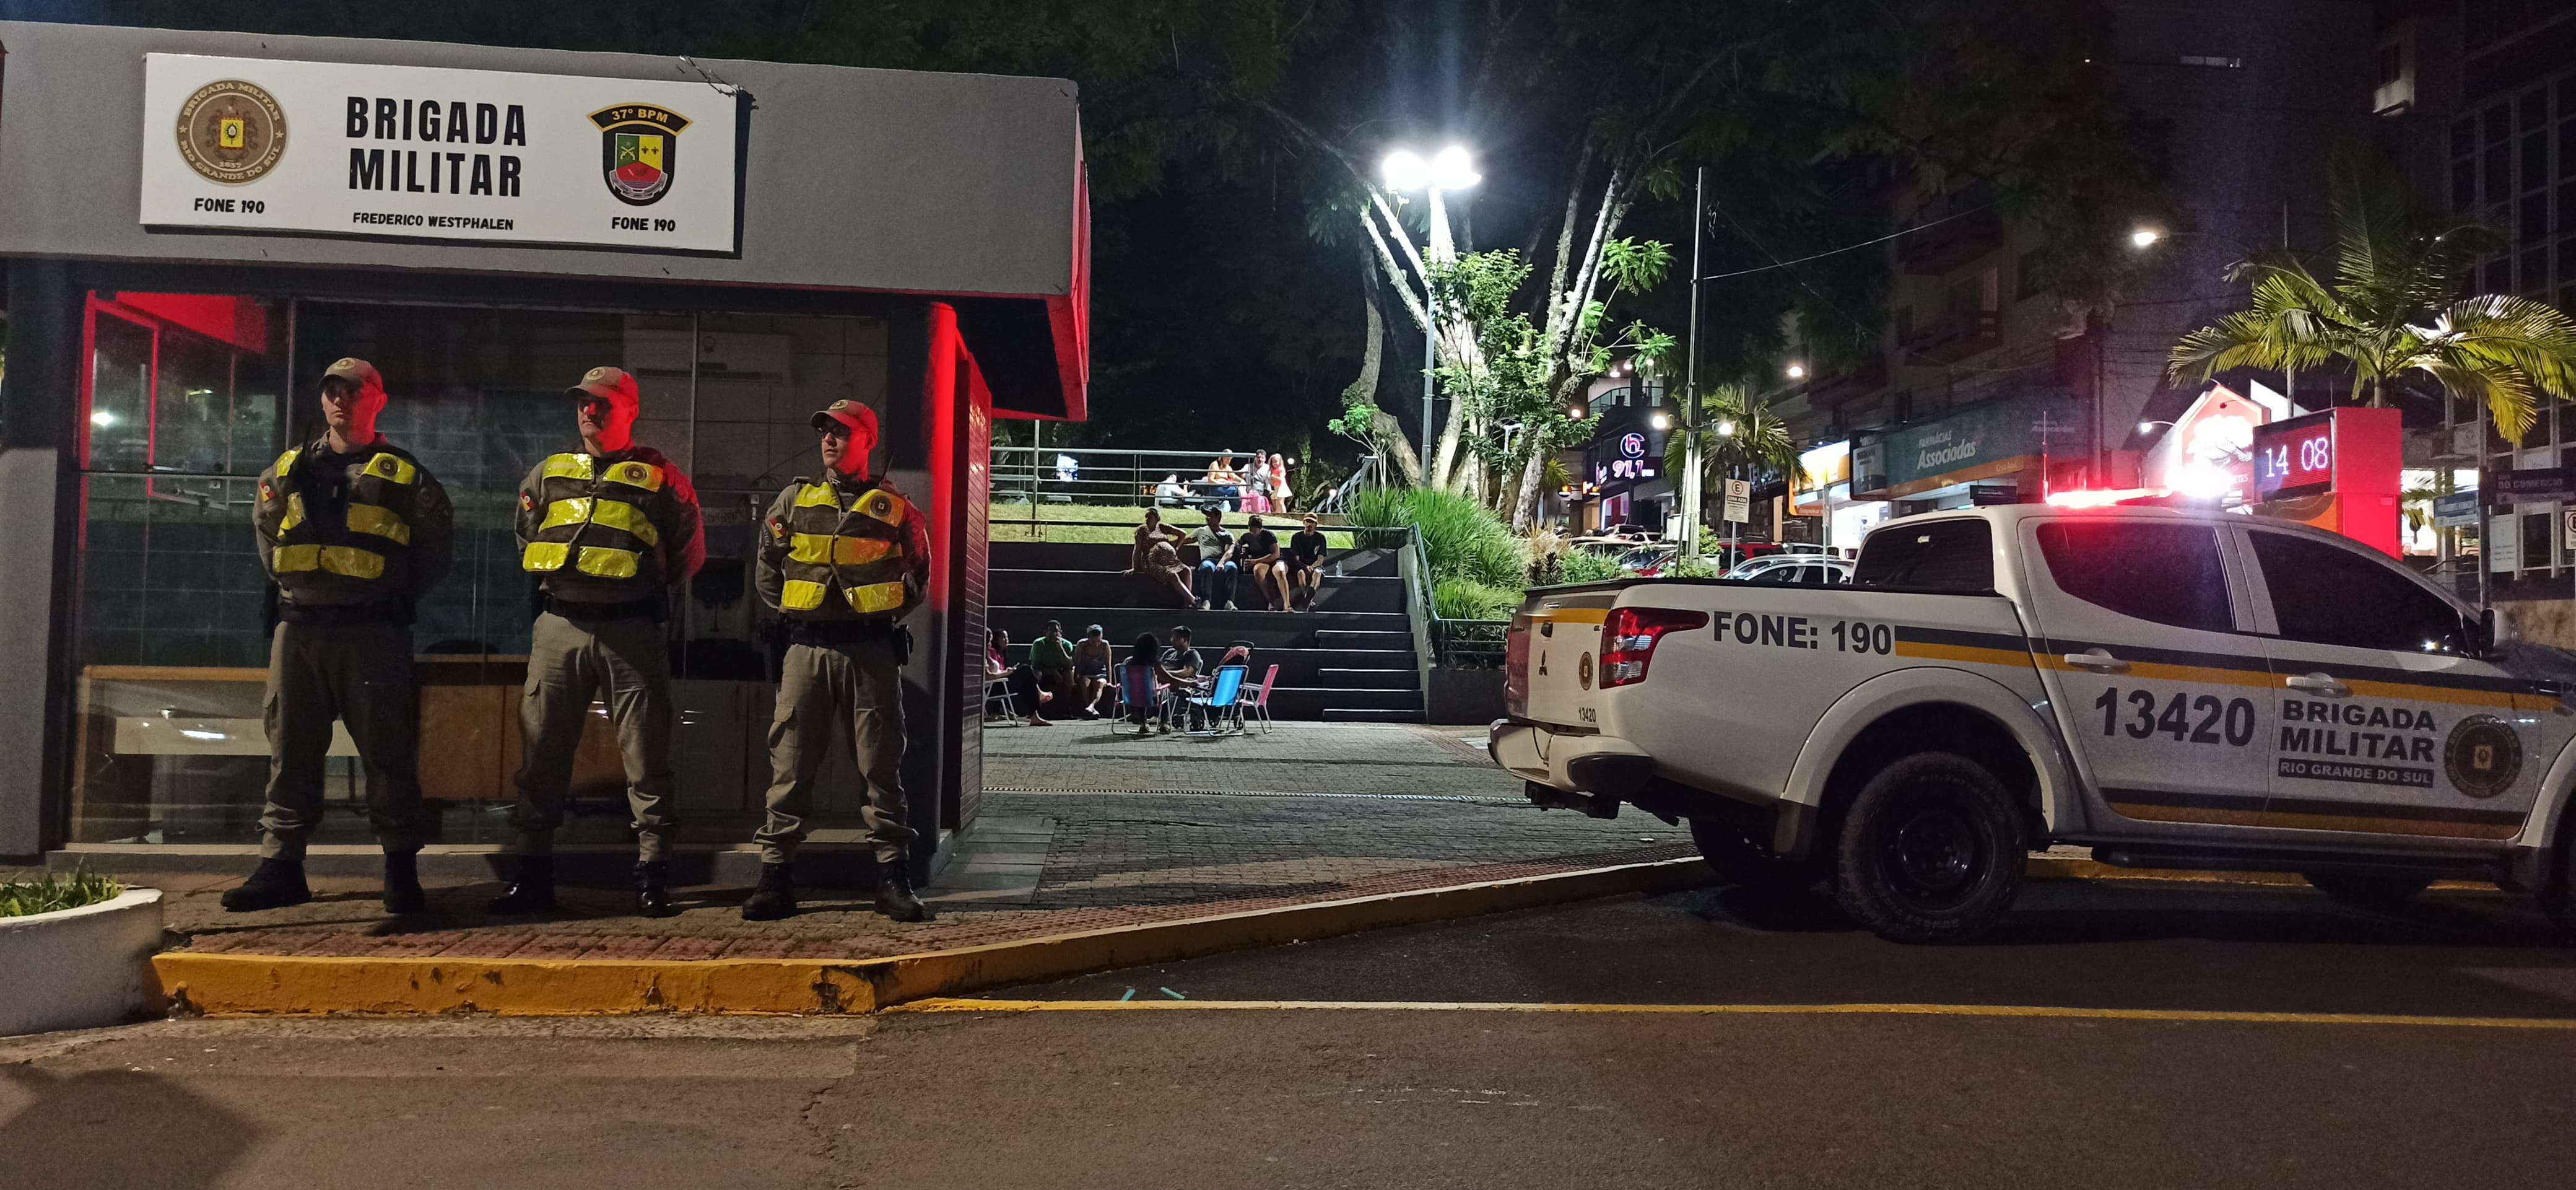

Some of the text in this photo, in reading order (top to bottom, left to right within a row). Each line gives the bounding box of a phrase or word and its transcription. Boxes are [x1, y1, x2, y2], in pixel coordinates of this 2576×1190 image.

[183, 82, 281, 121] BRIGADA MILITAR
[637, 108, 669, 123] BPM
[346, 96, 526, 146] BRIGADA
[181, 140, 281, 180] RIO GRANDE DO SUL
[349, 147, 521, 198] MILITAR
[194, 198, 265, 214] FONE 190
[352, 212, 513, 230] FREDERICO WESTPHALEN
[611, 217, 676, 232] FONE 190
[1917, 439, 1977, 470] Associadas
[2265, 436, 2328, 478] 14 08
[1735, 484, 1741, 492] E
[1713, 611, 1892, 655] FONE: 190
[1579, 707, 1596, 723] 13420
[2095, 686, 2255, 747] 13420
[2282, 699, 2437, 732] BRIGADA
[2279, 726, 2435, 763] MILITAR
[2280, 763, 2431, 784] RIO GRANDE DO SUL
